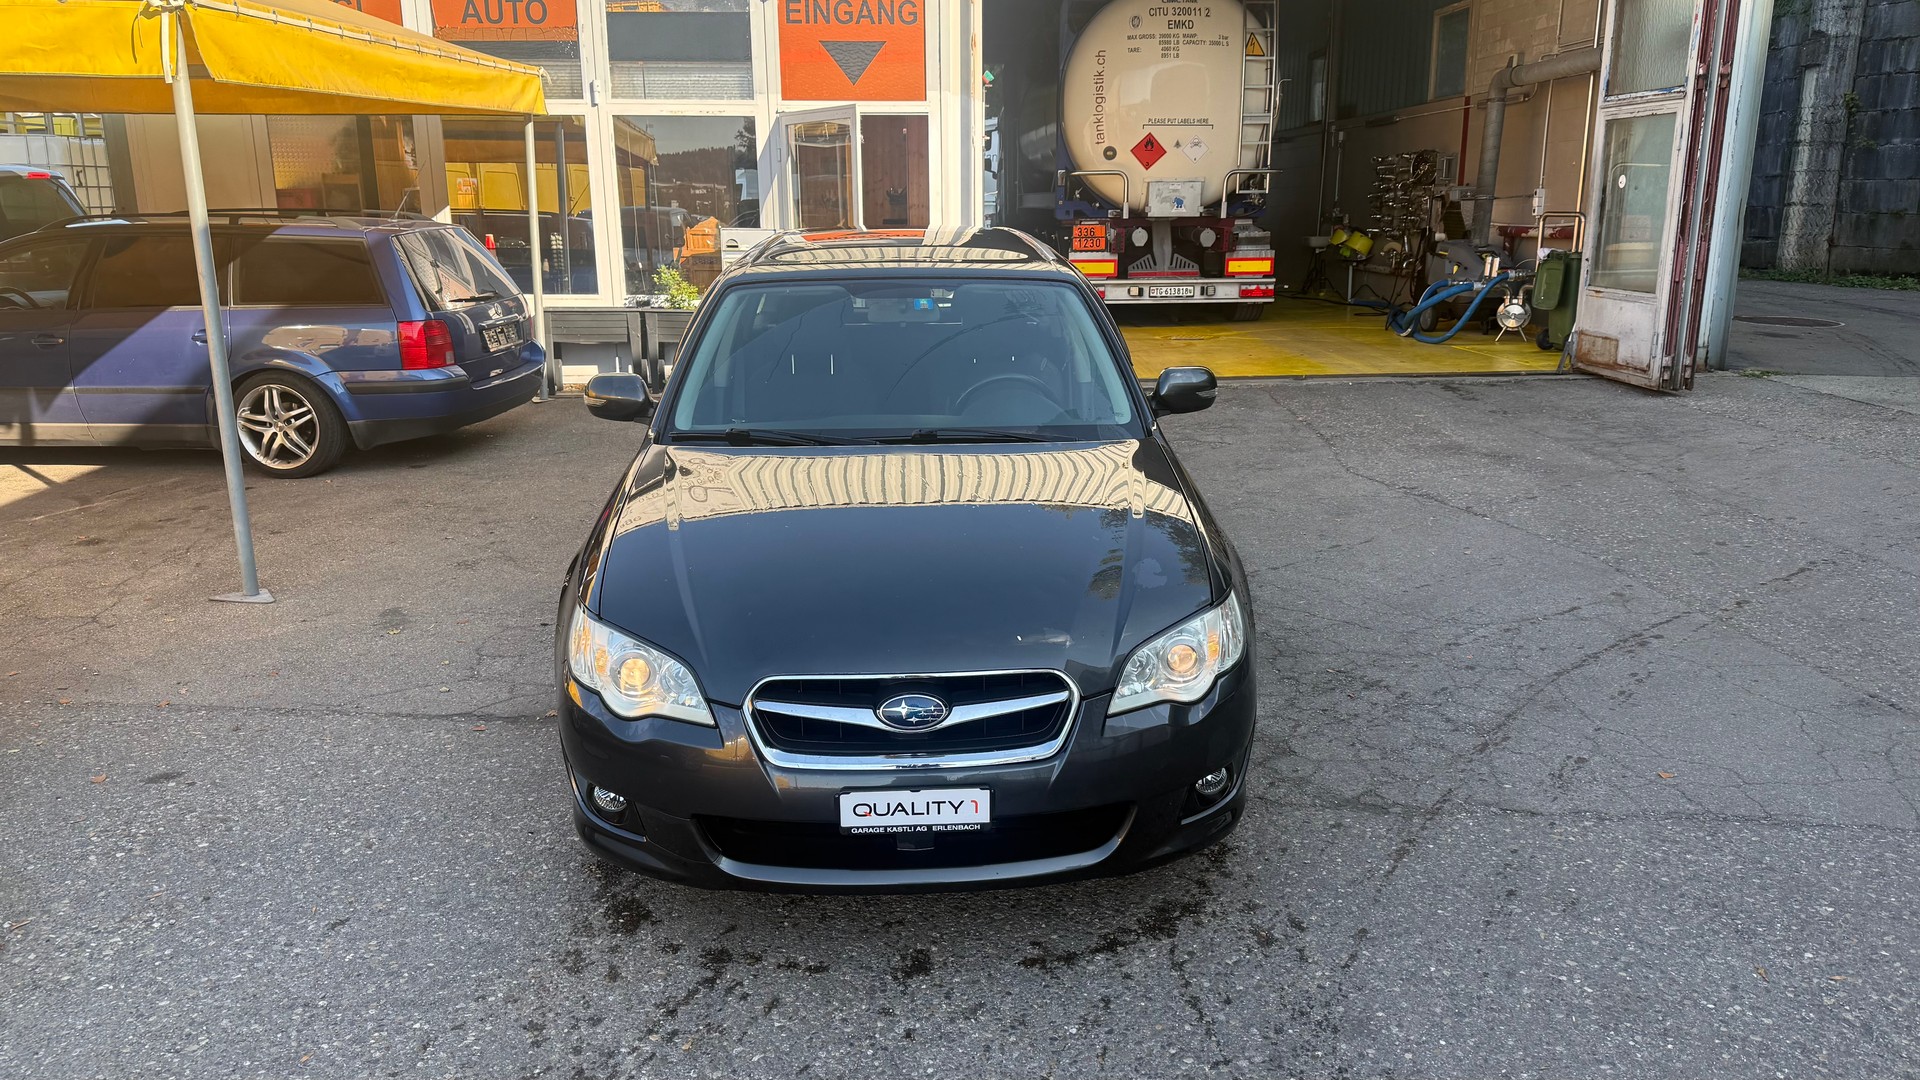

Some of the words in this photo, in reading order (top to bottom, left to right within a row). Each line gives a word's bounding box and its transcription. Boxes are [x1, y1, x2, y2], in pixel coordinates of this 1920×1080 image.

[461, 0, 548, 25] AUTO
[785, 0, 918, 26] EINGANG
[1148, 7, 1169, 17] CITU
[1171, 7, 1202, 17] 320011
[1204, 7, 1211, 18] 2
[1167, 19, 1195, 30] EMKD
[1092, 49, 1107, 145] tanklogistik.ch
[1077, 227, 1095, 237] 336
[1078, 238, 1101, 248] 1230
[852, 800, 965, 817] QUALITY
[932, 824, 981, 832] ERLENBACH
